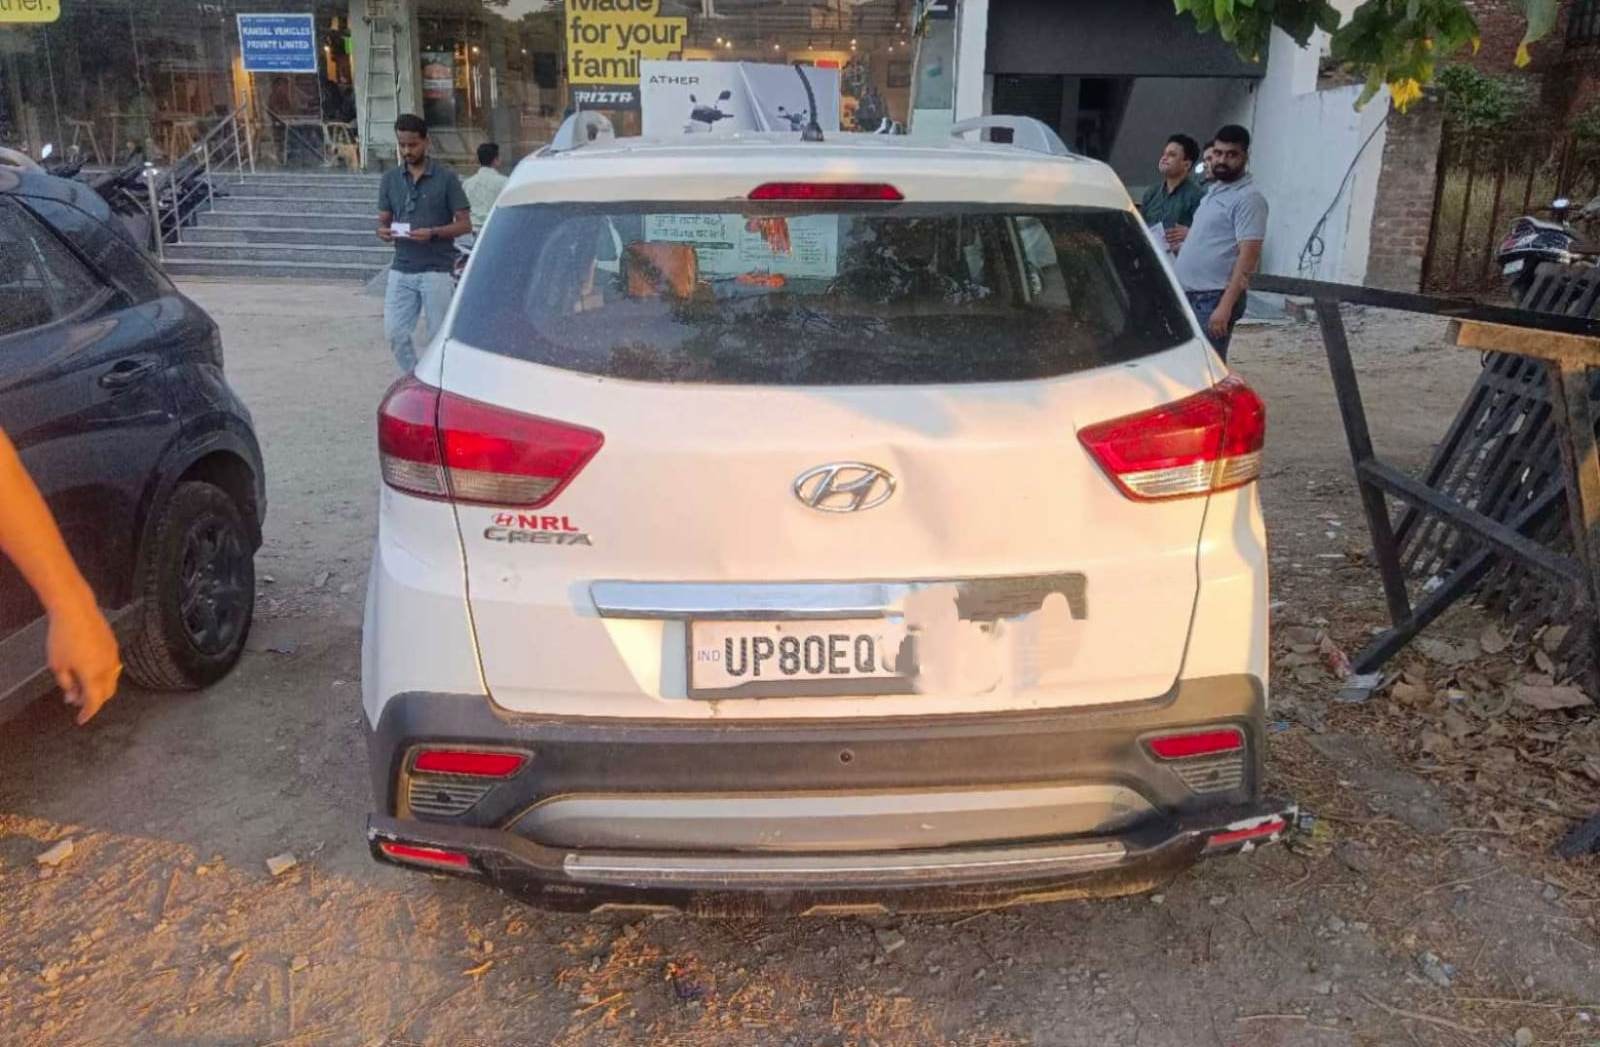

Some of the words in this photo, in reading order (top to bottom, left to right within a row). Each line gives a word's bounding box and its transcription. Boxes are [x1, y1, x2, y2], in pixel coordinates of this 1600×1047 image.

[571, 16, 612, 44] for
[616, 23, 682, 51] your
[247, 40, 277, 49] PRIVATE
[279, 40, 309, 49] LIMITED
[572, 50, 641, 78] famil
[649, 75, 700, 85] ATHER
[483, 527, 593, 546] CRETA
[697, 650, 720, 662] IND
